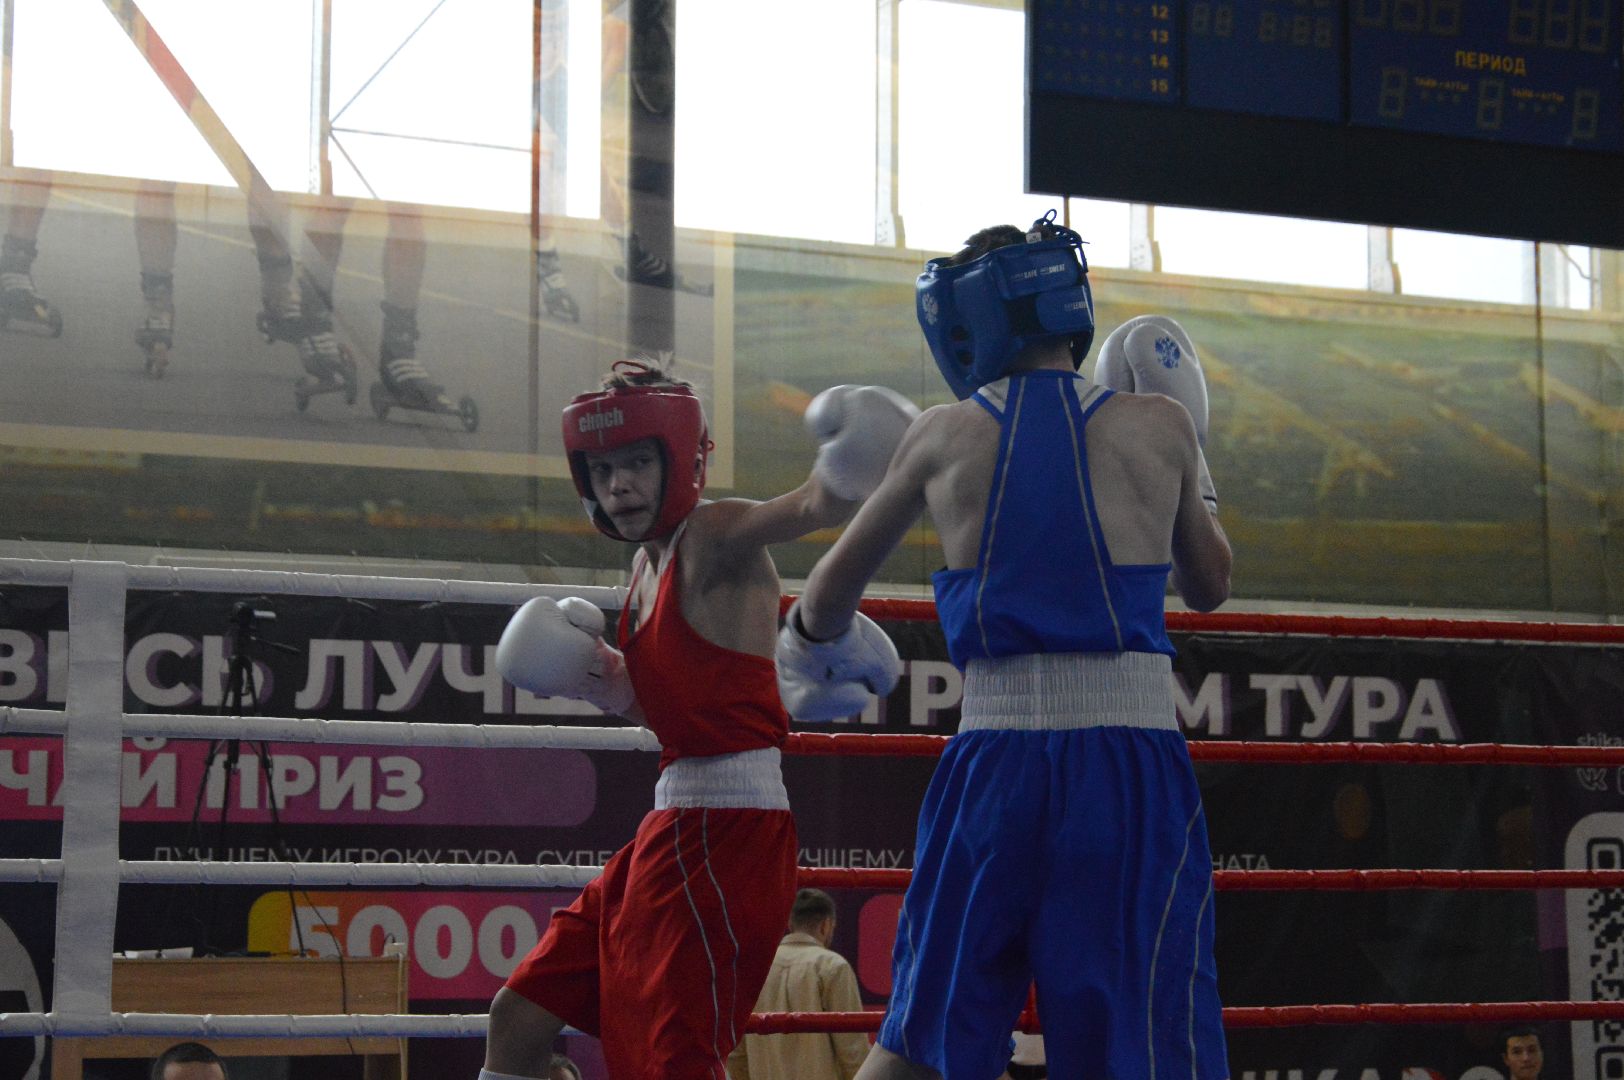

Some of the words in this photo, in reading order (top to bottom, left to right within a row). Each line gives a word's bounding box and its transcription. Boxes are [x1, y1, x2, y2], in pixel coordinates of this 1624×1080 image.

[1151, 5, 1168, 19] 12
[1151, 29, 1168, 43] 13
[1151, 54, 1168, 69] 14
[1455, 50, 1527, 76] ПЕРИОД
[1151, 79, 1168, 93] 15
[1249, 674, 1458, 740] ТУРА
[1577, 732, 1624, 747] shika
[206, 755, 424, 812] ПРИЗ
